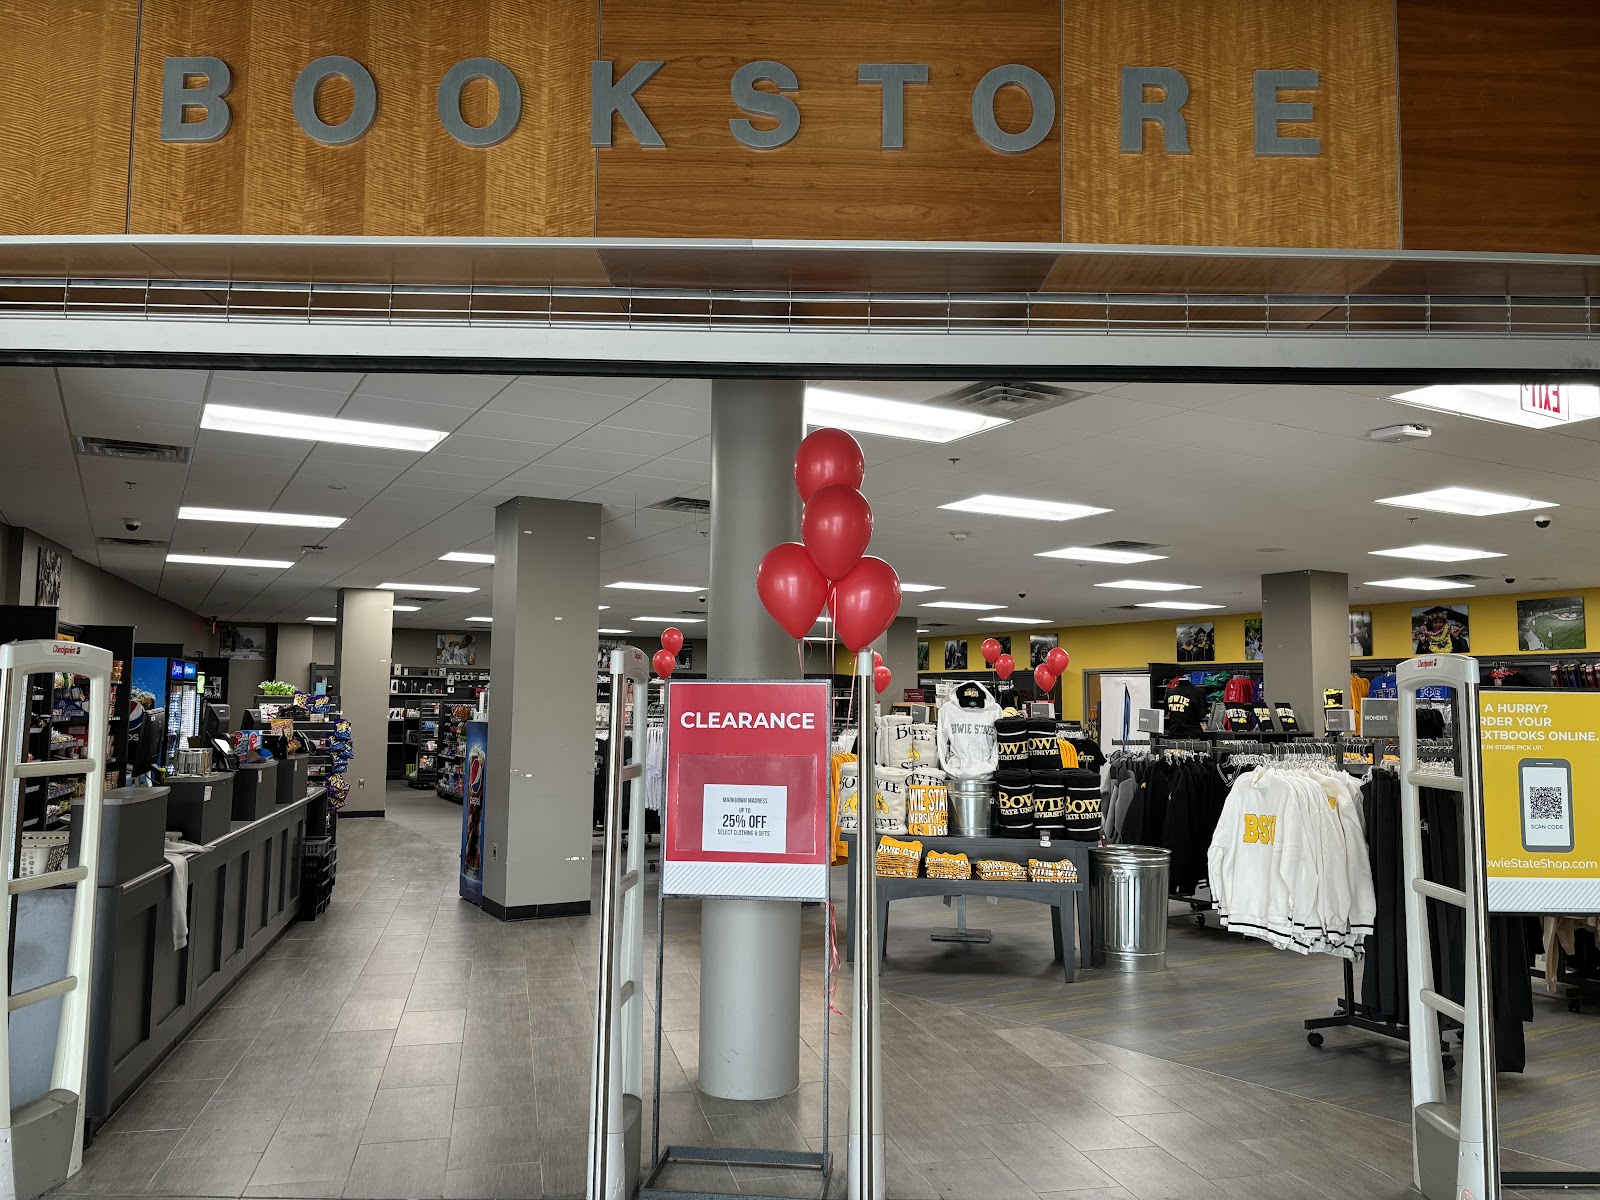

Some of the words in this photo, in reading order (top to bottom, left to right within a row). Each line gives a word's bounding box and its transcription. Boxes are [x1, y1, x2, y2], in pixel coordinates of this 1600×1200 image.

[160, 55, 1321, 157] BOOKSTORE
[1168, 704, 1184, 712] TATE
[1484, 703, 1494, 713] A
[1497, 703, 1548, 713] HURRY?
[680, 711, 815, 729] CLEARANCE
[1480, 716, 1513, 726] RDER
[1516, 717, 1552, 727] YOUR
[1480, 730, 1545, 741] EXTBOOKS
[1548, 731, 1600, 741] ONLINE.
[722, 796, 747, 804] MARKDOWN
[909, 788, 926, 811] WIE
[928, 788, 948, 811] STAT
[998, 791, 1034, 808] BOW
[1034, 797, 1065, 812] WIE
[1065, 796, 1102, 813] BOW
[722, 814, 746, 828] 25%
[748, 815, 767, 829] OFF
[717, 828, 733, 836] SELECT
[1486, 857, 1598, 871] owieStateShop.com
